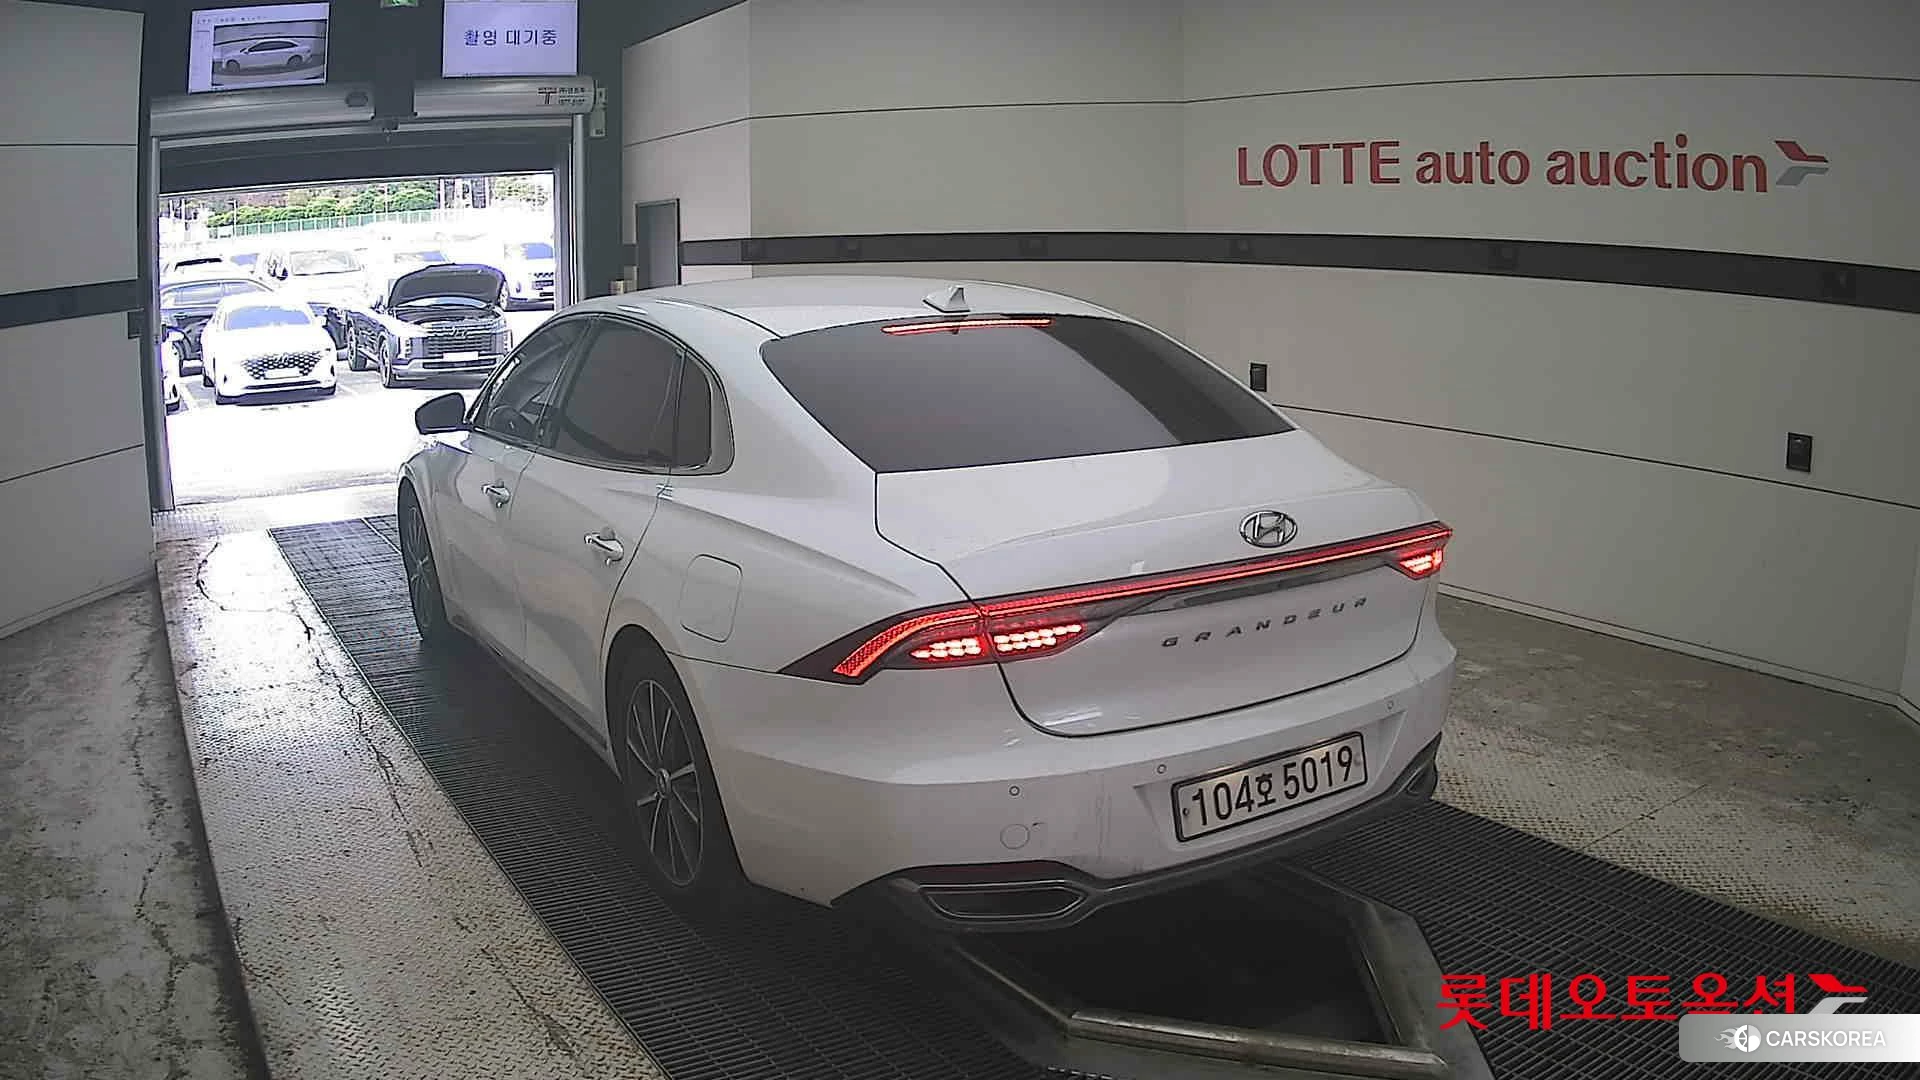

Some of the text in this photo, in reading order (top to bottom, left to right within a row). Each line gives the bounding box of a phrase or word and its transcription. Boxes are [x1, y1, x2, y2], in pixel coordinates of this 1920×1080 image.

[504, 29, 558, 46] 대기중
[1237, 132, 1769, 194] LOTTE auto auction
[1161, 598, 1367, 647] GRANDEUR
[1192, 745, 1353, 826] 104호 5019
